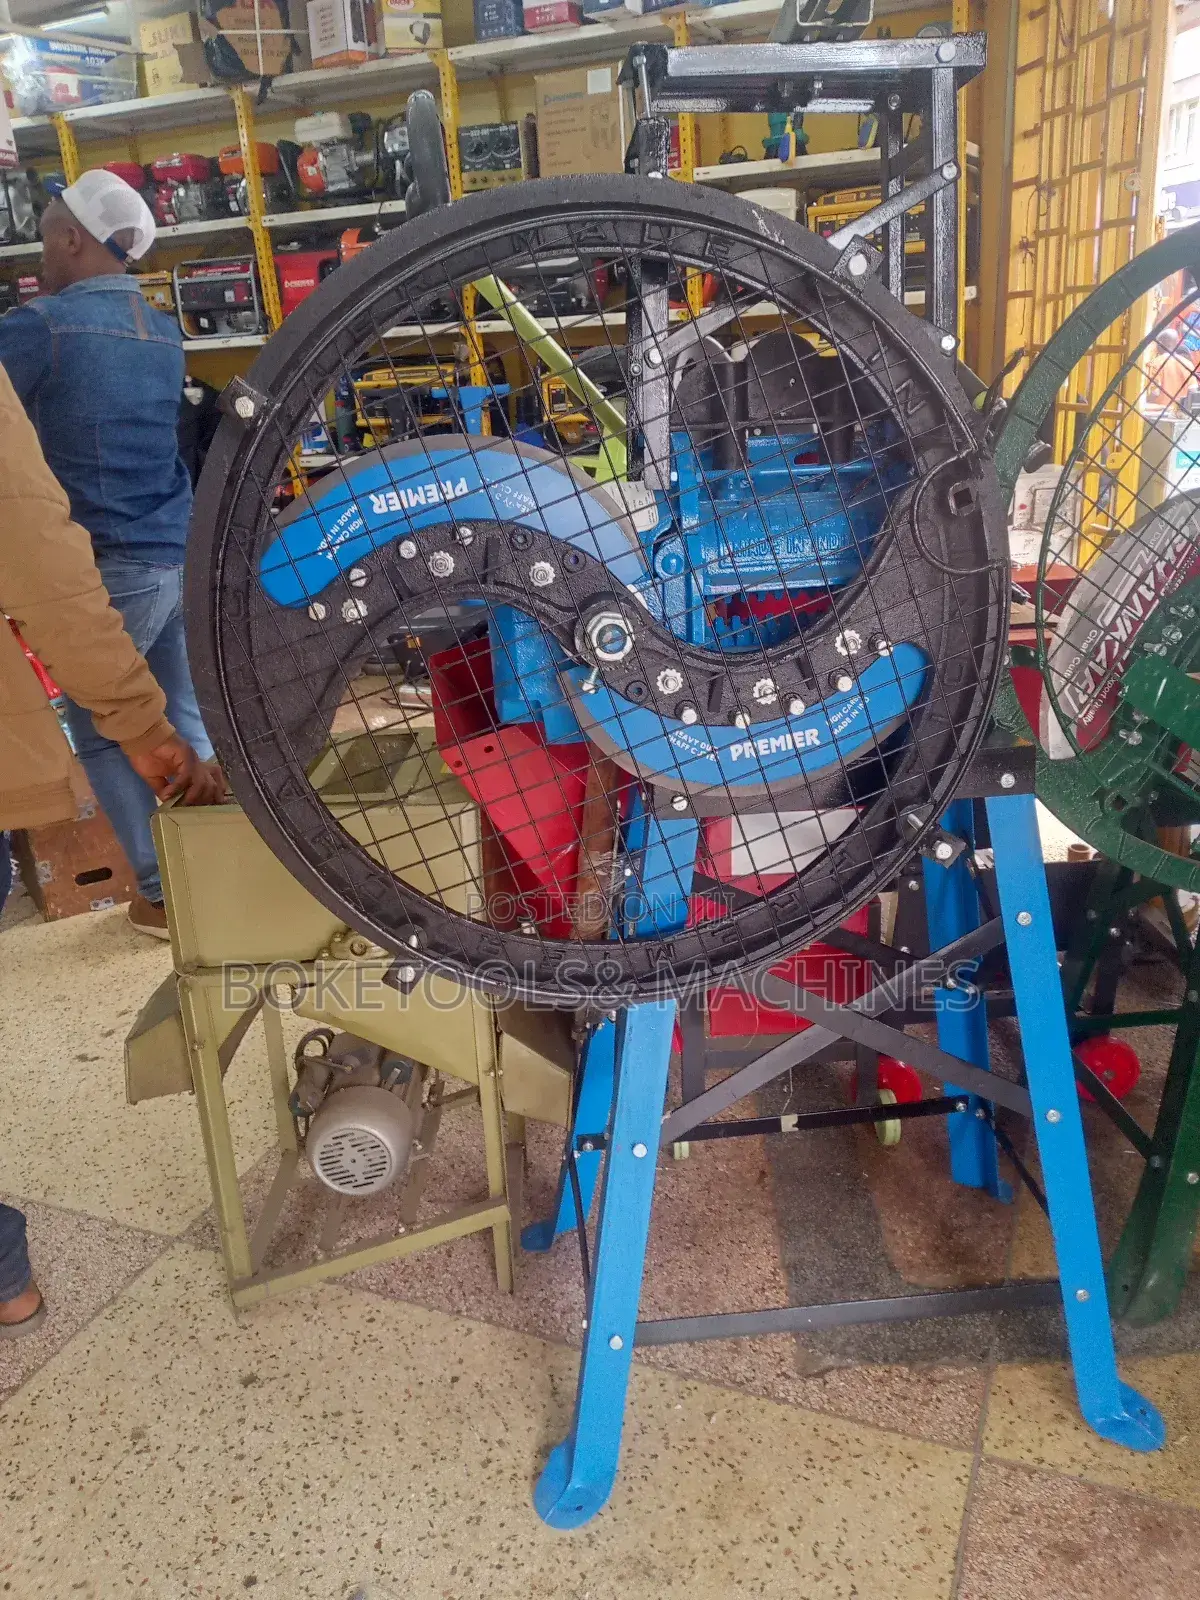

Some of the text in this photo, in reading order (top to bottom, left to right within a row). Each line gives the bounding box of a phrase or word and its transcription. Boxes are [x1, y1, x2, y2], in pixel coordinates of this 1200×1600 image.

[368, 476, 470, 515] PREMIER
[512, 491, 541, 509] HAFF
[337, 503, 358, 527] MADE
[664, 734, 691, 751] HAFF
[729, 727, 822, 762] PREMIER
